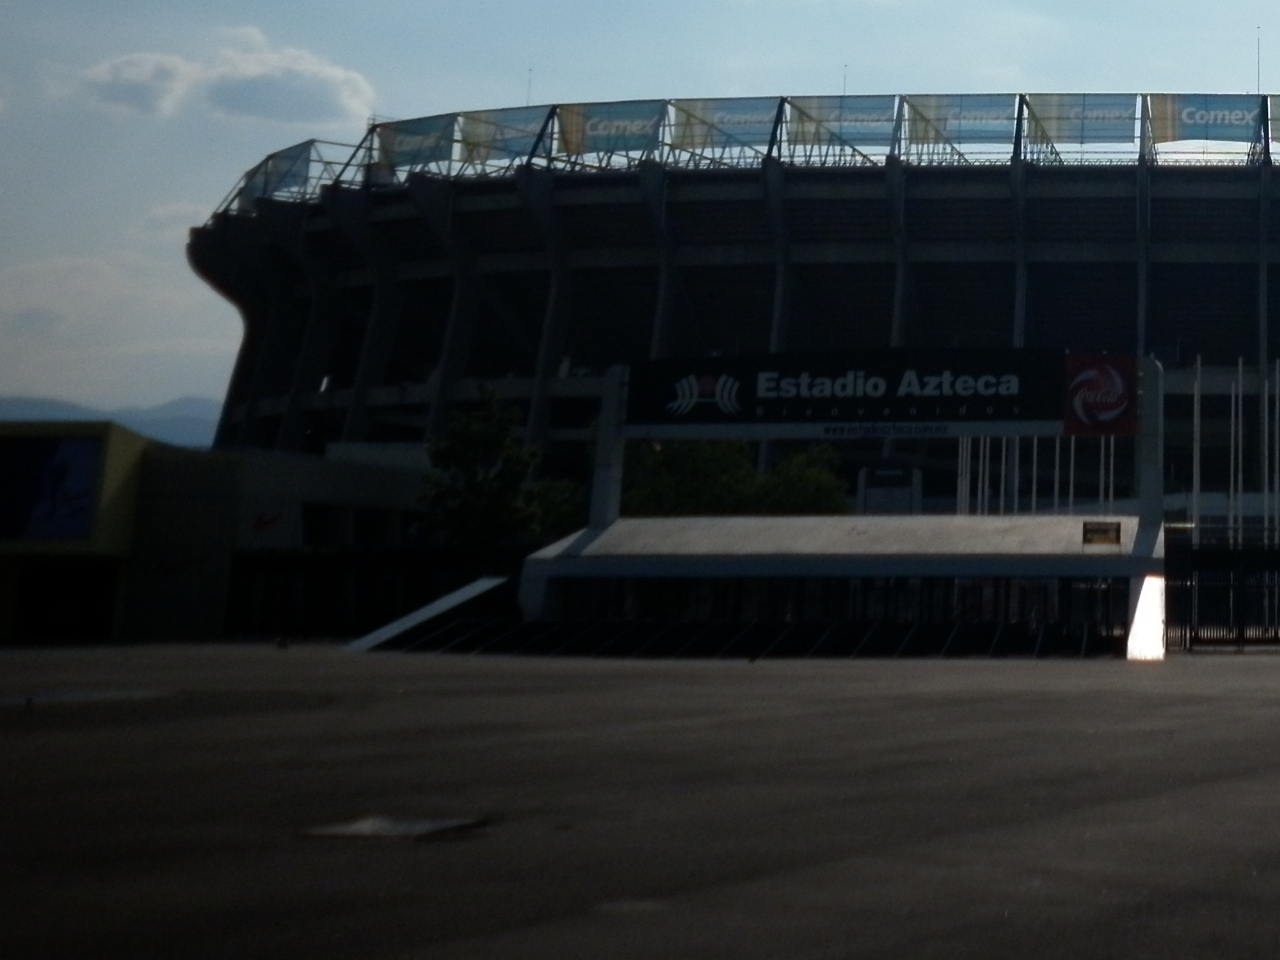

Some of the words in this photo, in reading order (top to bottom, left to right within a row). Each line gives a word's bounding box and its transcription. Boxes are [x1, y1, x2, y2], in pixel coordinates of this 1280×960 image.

[713, 110, 777, 124] Comex
[949, 107, 1014, 123] Comex
[1069, 108, 1135, 123] Comex
[1181, 107, 1261, 125] Comex
[585, 116, 657, 135] Comex
[756, 370, 887, 398] Estadio
[896, 368, 1020, 397] Azteca
